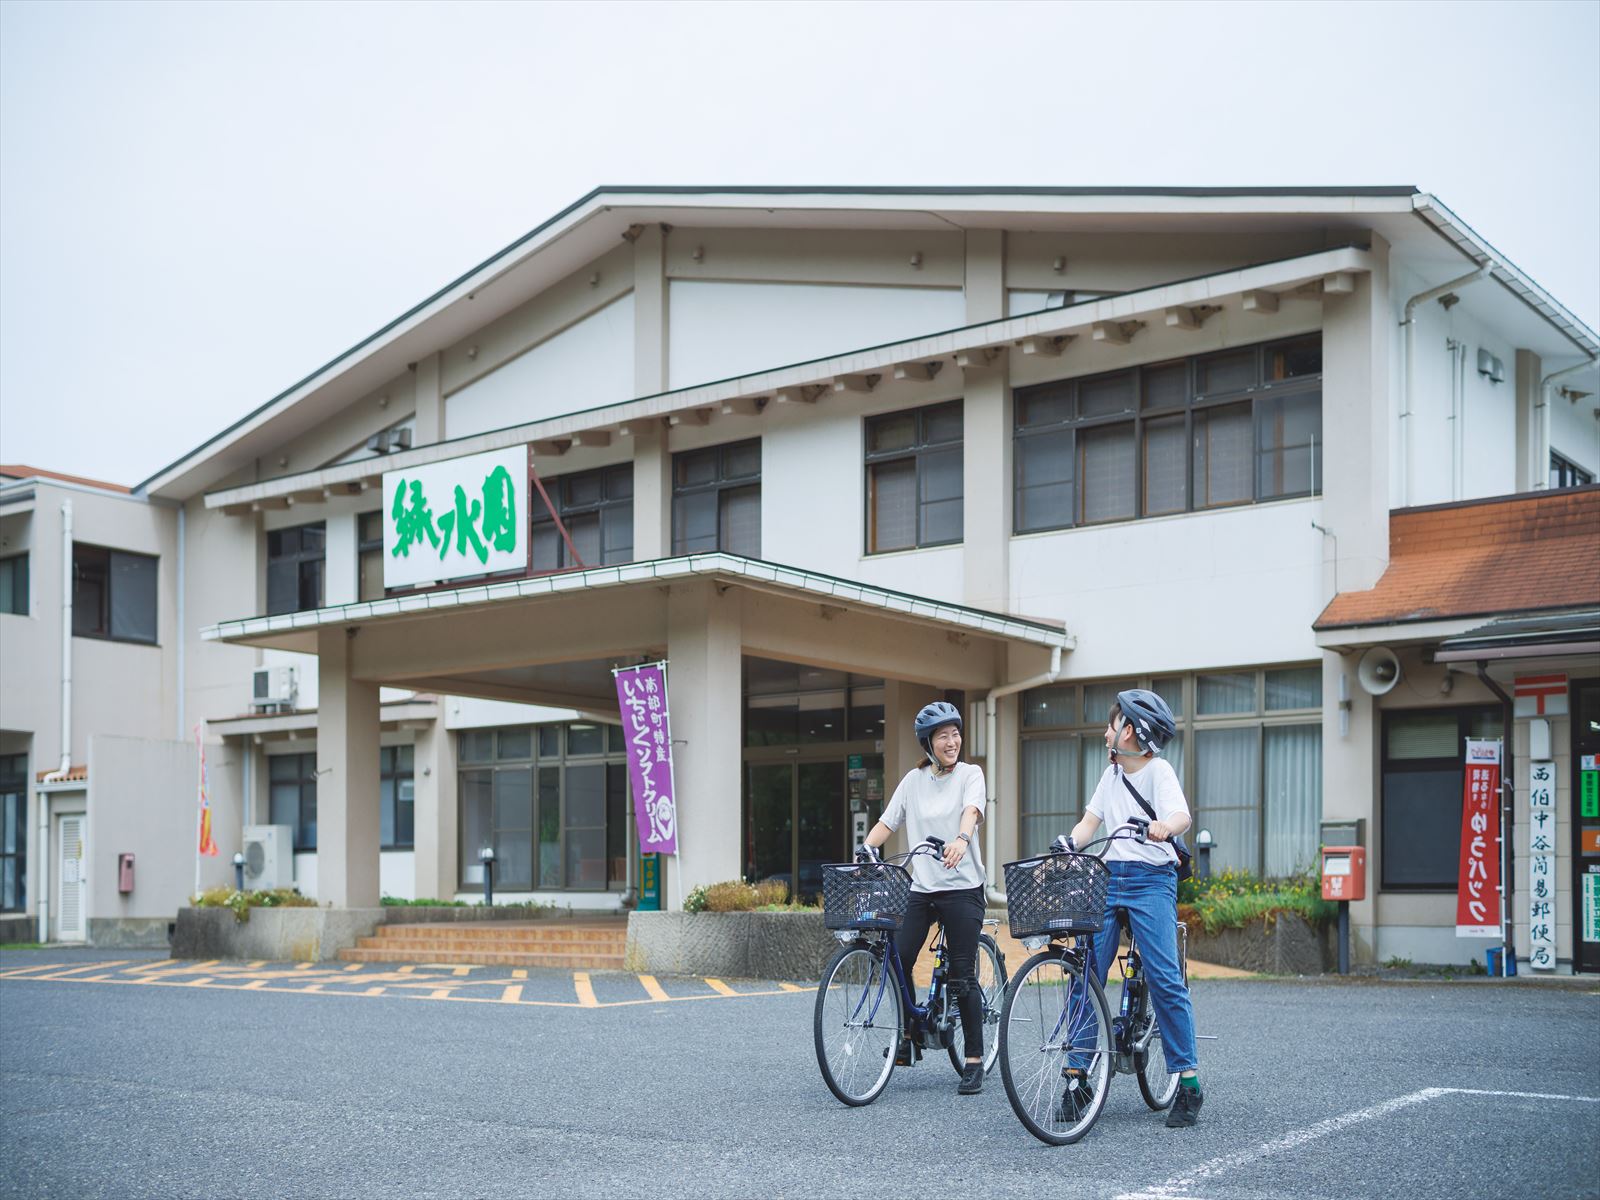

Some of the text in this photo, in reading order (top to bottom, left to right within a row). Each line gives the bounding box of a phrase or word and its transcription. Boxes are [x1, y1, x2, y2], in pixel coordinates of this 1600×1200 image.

[623, 677, 663, 844] いちじくソフトクリーム
[644, 676, 667, 763] 南部町特産
[1531, 767, 1552, 966] 西伯中谷簡易郵便局
